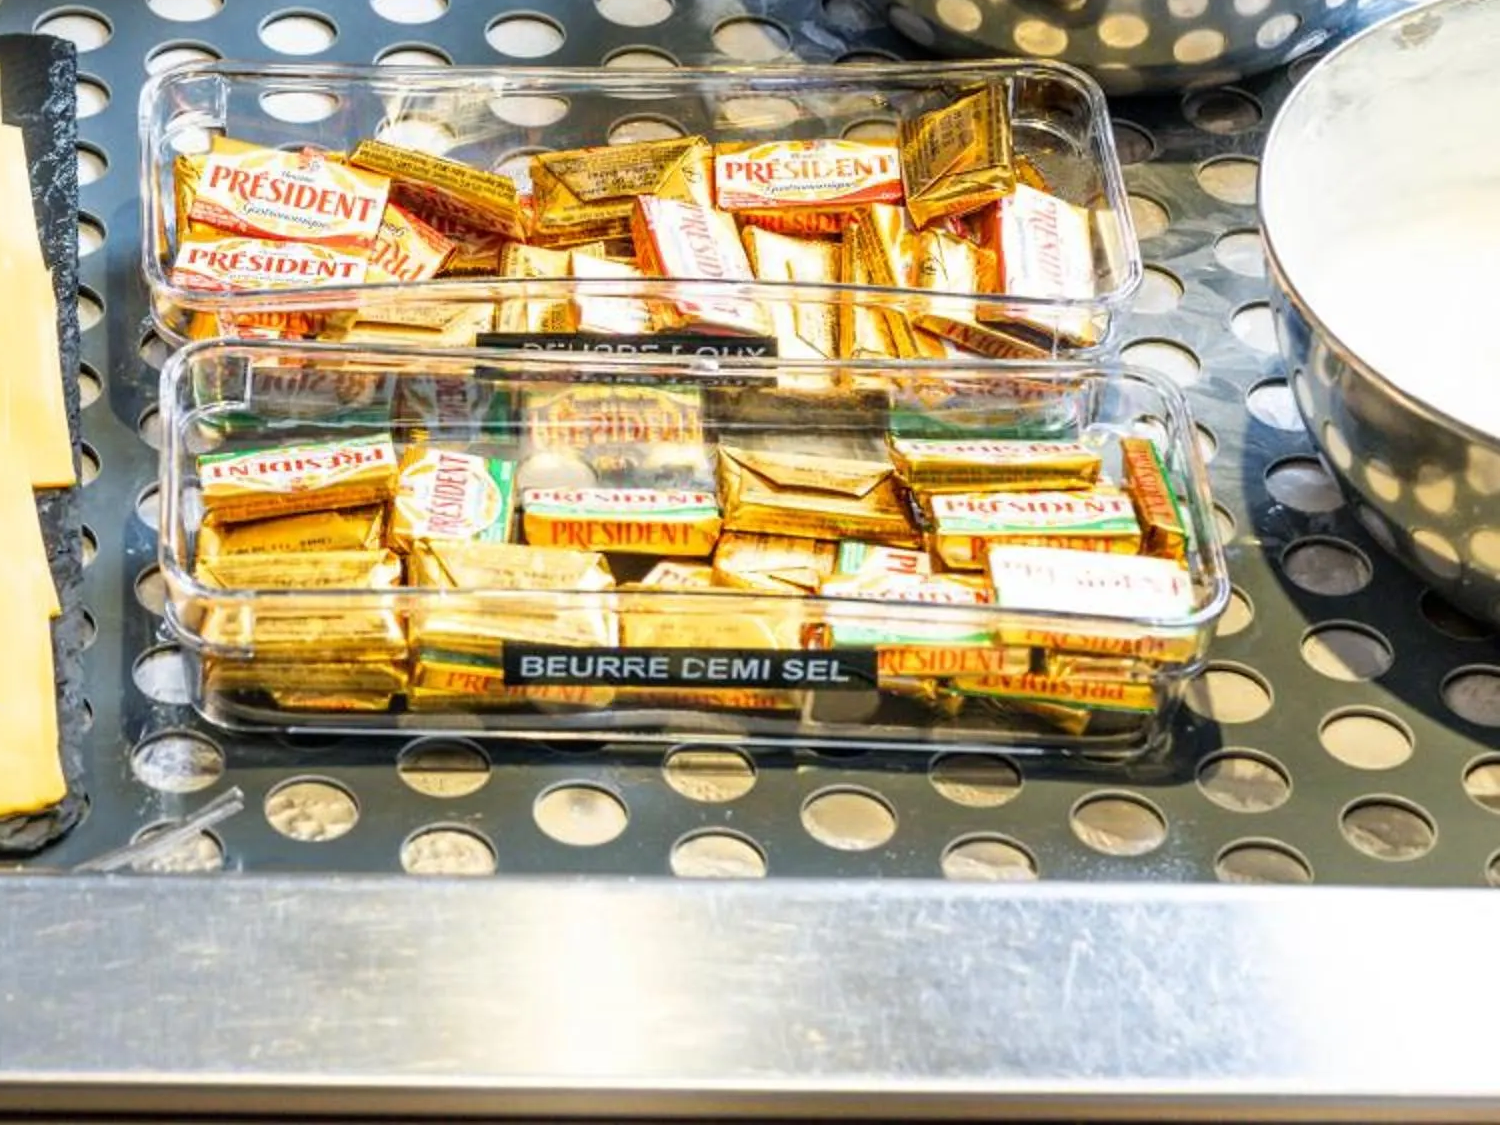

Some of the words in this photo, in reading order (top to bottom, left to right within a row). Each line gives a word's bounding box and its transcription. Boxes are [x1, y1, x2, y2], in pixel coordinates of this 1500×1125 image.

[725, 155, 890, 184] PRÉSIDENT
[209, 164, 376, 223] PRÉSIDENT
[187, 248, 360, 278] PRÉSIDENT
[520, 655, 668, 679] BEURRE
[681, 658, 771, 681] DEMI
[781, 659, 850, 684] SEL
